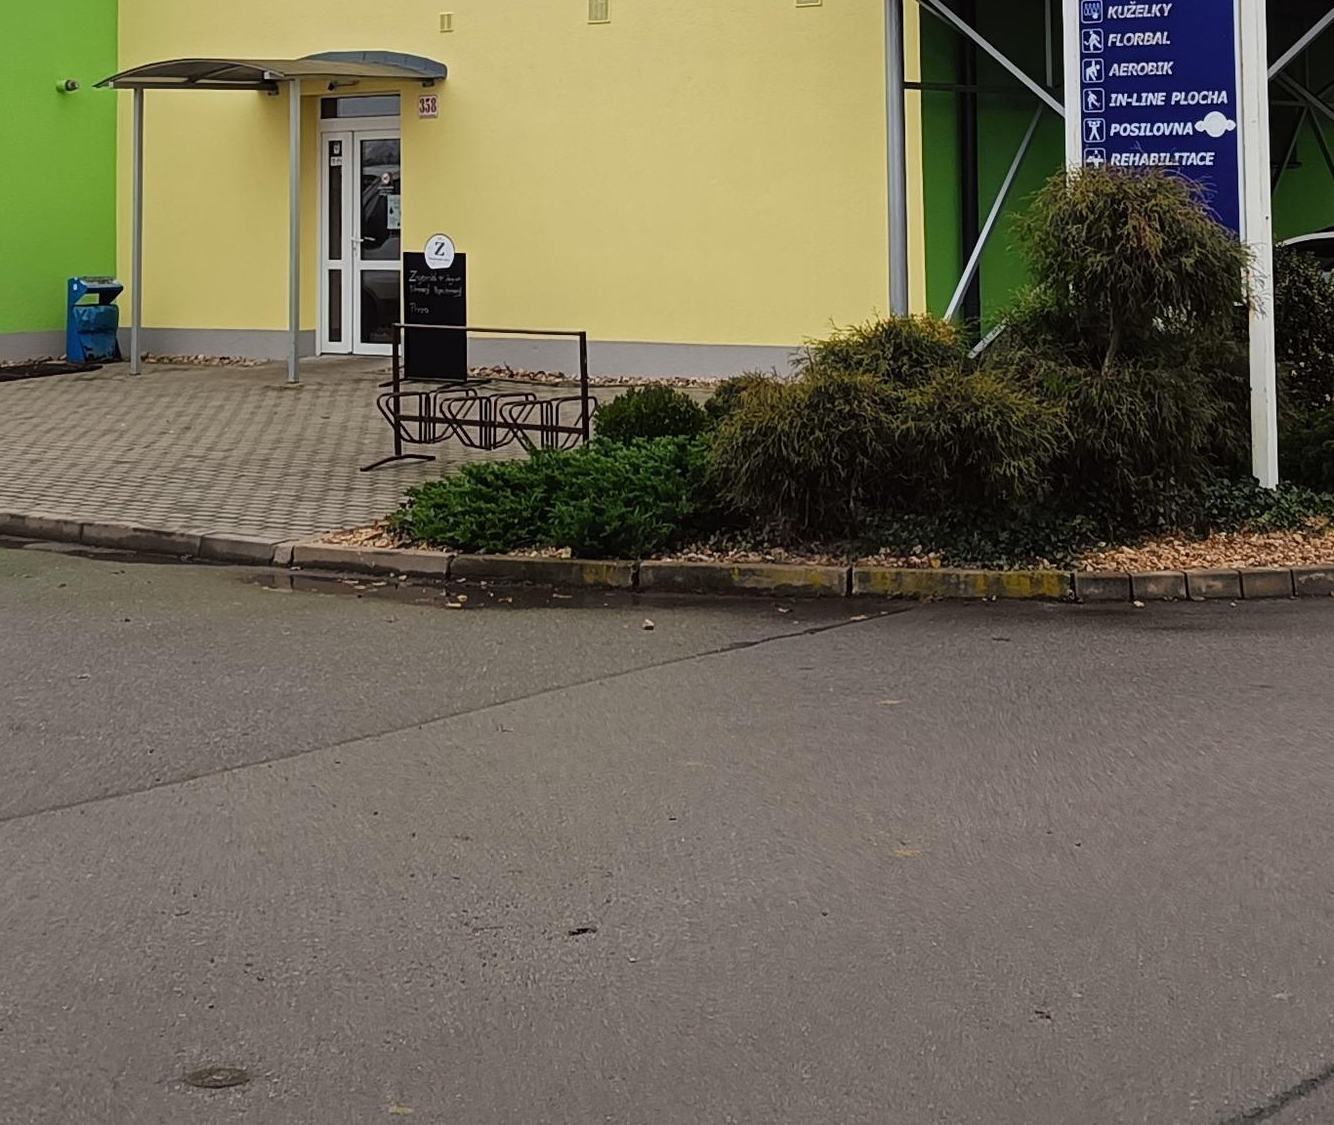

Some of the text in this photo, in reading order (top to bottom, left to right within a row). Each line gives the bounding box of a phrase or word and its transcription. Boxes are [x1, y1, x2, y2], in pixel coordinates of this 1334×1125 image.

[1107, 1, 1172, 19] KUŽELKY
[1107, 32, 1171, 47] FLORBAL
[1109, 61, 1174, 77] AEROBIK
[419, 97, 437, 114] 358
[1109, 90, 1228, 107] IN-LINE PLOCHA
[1109, 122, 1194, 137] POSILOVNA
[1110, 152, 1216, 167] REHABILITACE
[434, 241, 445, 256] Z
